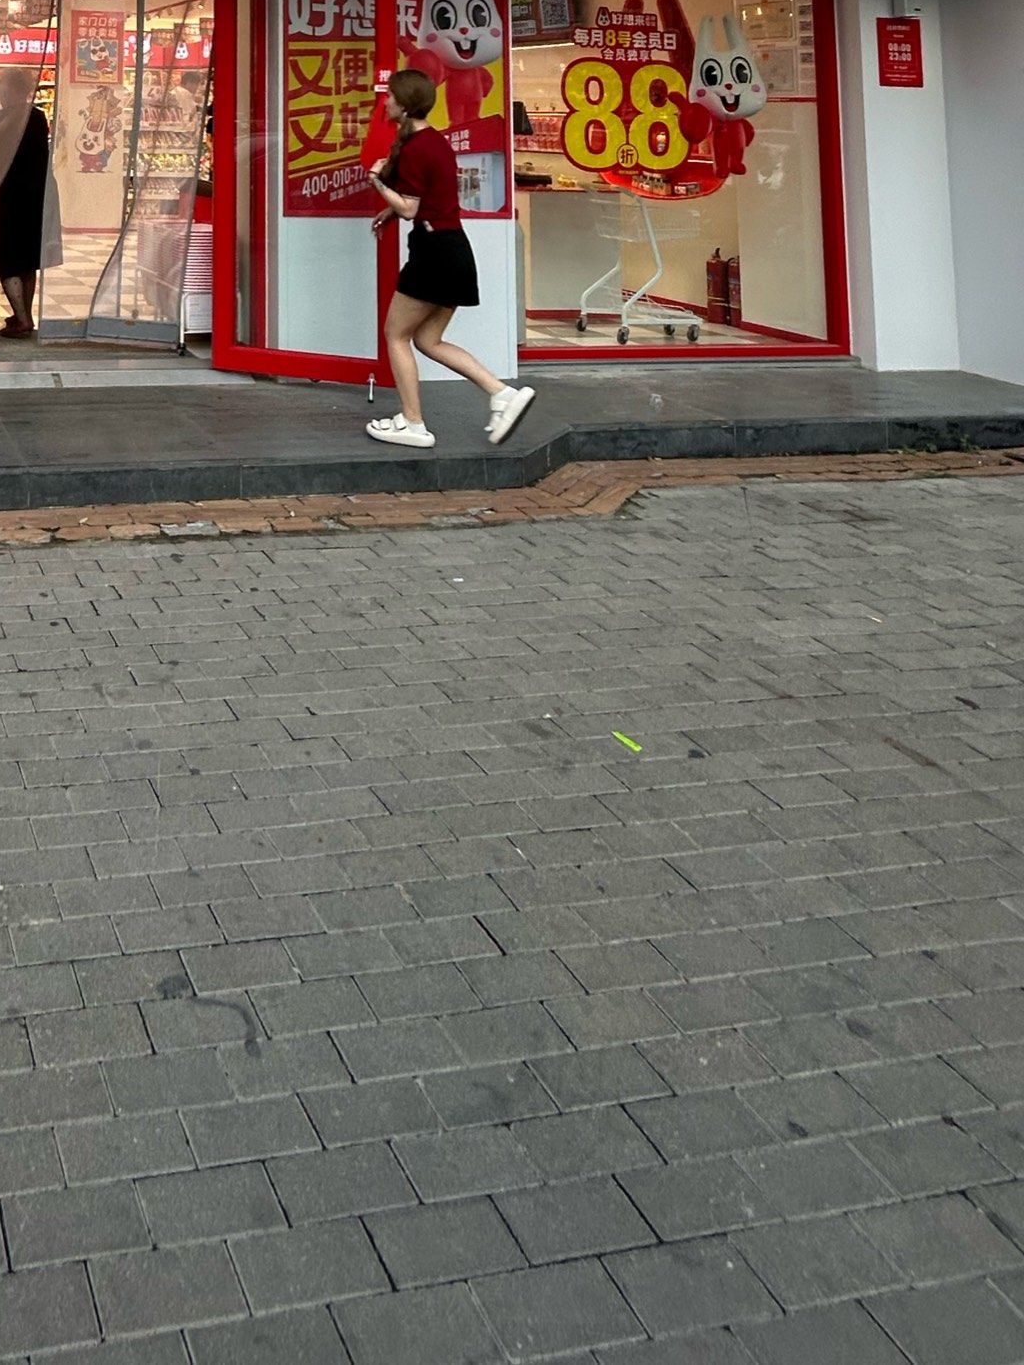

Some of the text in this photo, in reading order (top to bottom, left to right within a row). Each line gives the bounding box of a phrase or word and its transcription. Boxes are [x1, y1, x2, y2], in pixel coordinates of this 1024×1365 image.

[610, 13, 646, 26] 好想来
[573, 27, 677, 51] 每月8号会员日
[602, 48, 652, 62] 会员独享
[288, 48, 376, 101] 又便
[564, 61, 689, 171] 88
[288, 99, 377, 162] 又好
[620, 148, 635, 165] 折
